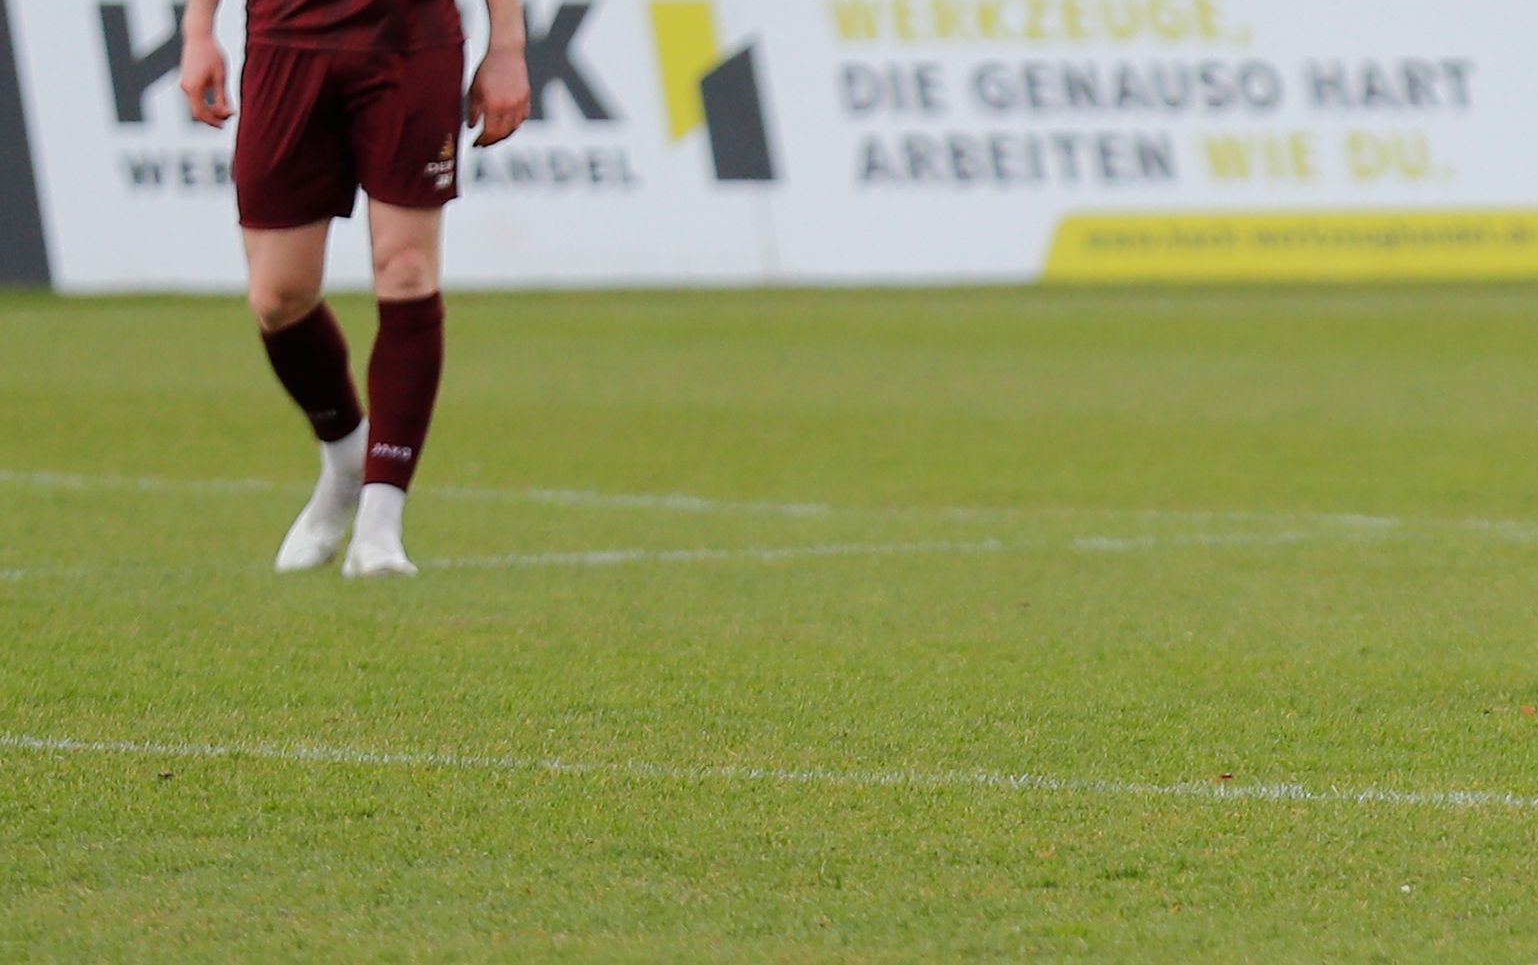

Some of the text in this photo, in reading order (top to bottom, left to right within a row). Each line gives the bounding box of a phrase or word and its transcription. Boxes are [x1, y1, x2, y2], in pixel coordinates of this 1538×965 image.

[843, 58, 1474, 111] DIE GENAUSO HART
[856, 133, 1177, 185] ARBEITEN
[1201, 131, 1321, 182] WIE
